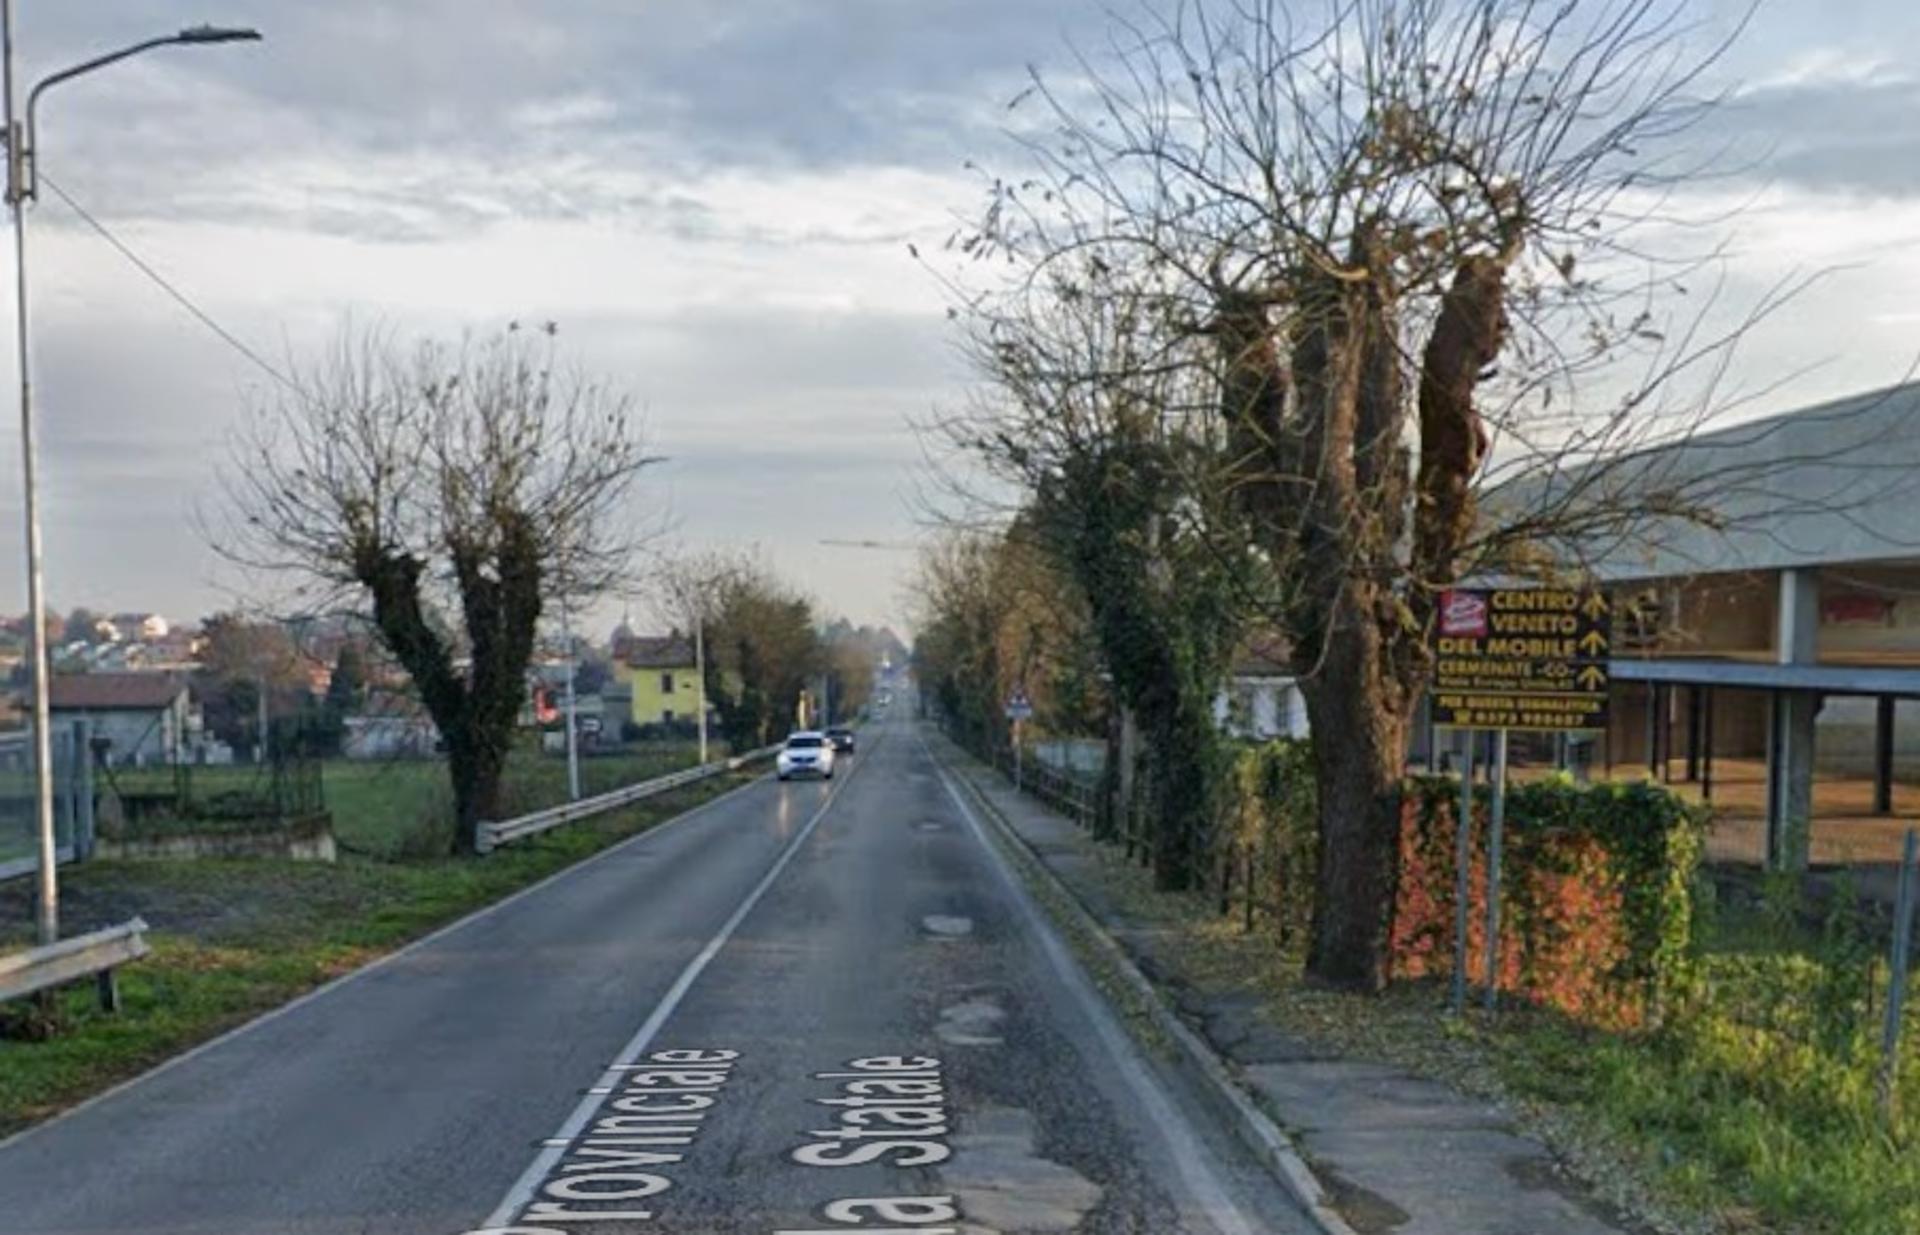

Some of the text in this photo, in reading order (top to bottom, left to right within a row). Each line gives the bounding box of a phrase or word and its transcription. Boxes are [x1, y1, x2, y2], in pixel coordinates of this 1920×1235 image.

[1492, 591, 1577, 609] CENTRO
[1492, 614, 1577, 633] VENETO
[1438, 638, 1577, 655] DEL MOBILE
